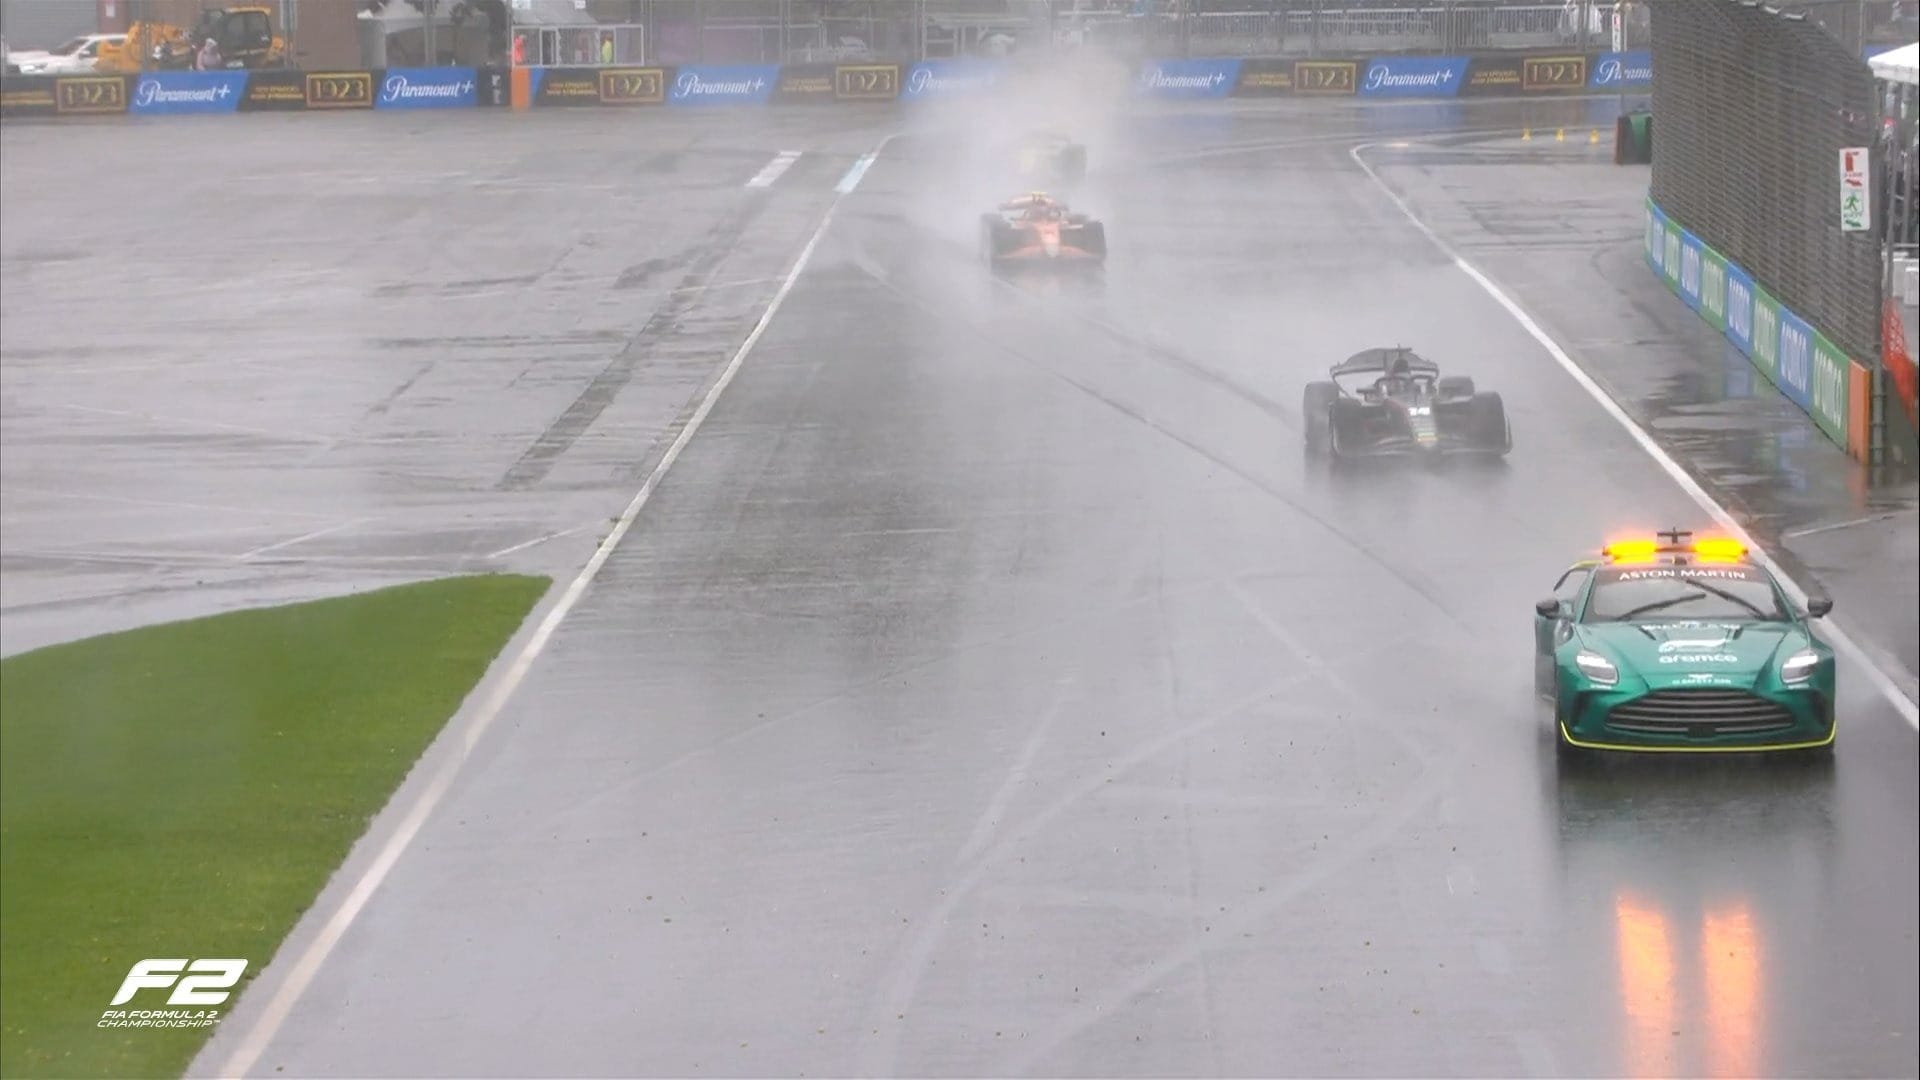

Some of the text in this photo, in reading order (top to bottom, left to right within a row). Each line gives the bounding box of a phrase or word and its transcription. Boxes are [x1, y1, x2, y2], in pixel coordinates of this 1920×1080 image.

[1365, 65, 1453, 90] Paramount+
[1531, 63, 1579, 82] 1923
[315, 78, 364, 98] 1923
[383, 75, 475, 101] Paramount+
[609, 76, 656, 94] 1923
[674, 72, 765, 98] Paramount+
[1619, 569, 1746, 581] ASTON MARTIN
[1659, 654, 1738, 664] aramco
